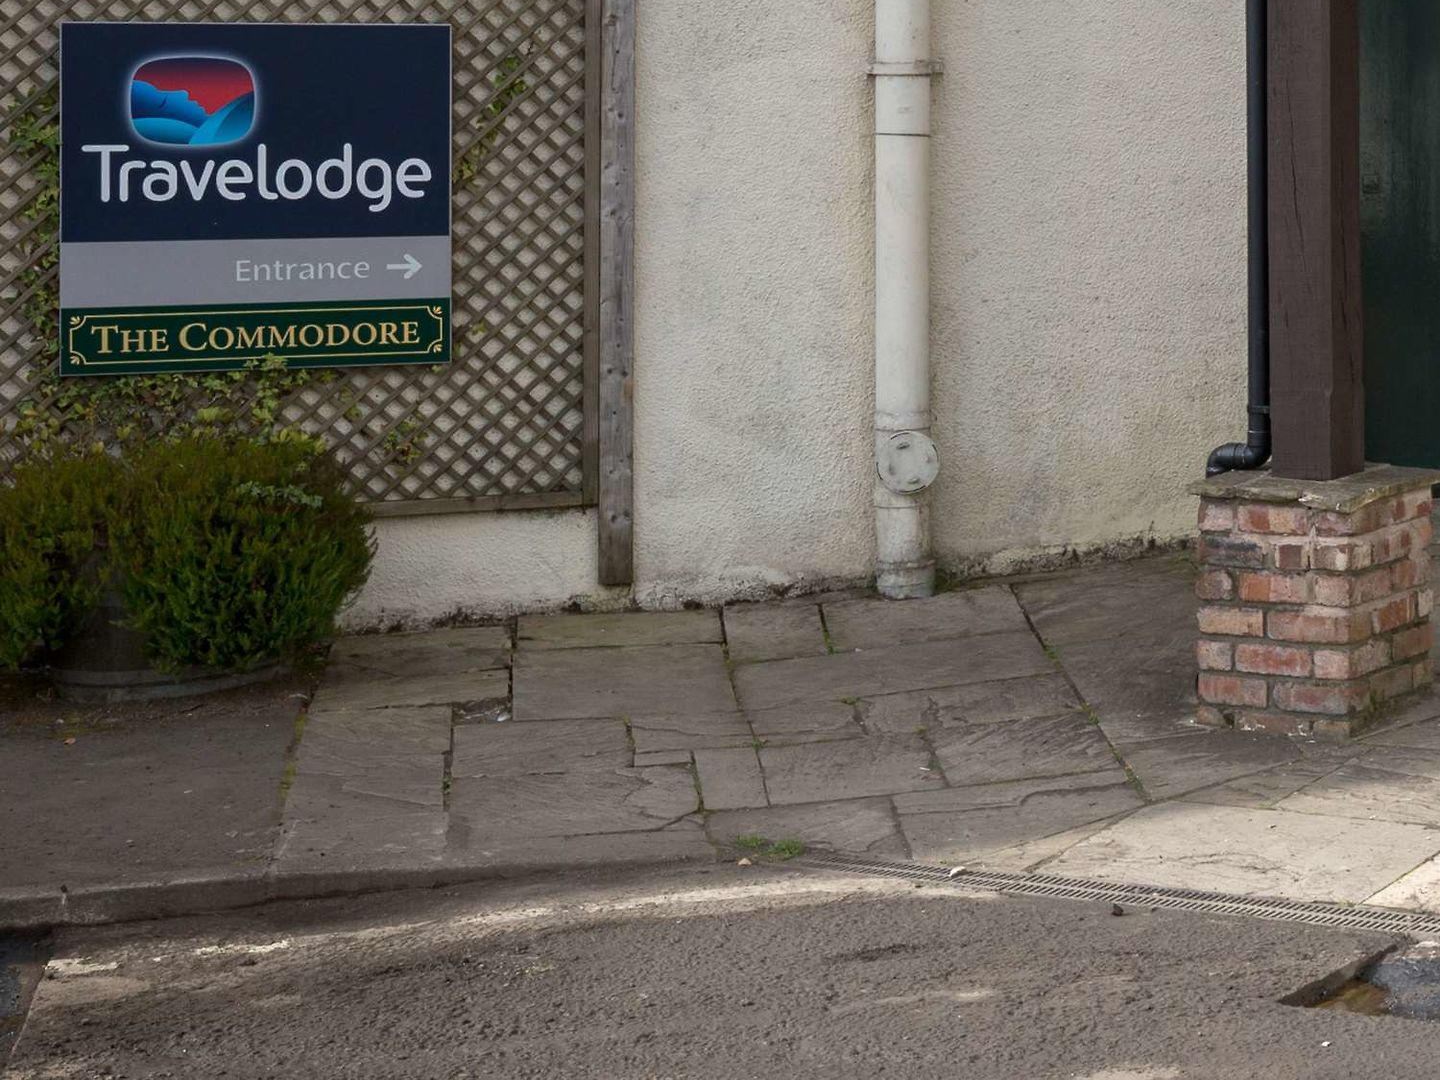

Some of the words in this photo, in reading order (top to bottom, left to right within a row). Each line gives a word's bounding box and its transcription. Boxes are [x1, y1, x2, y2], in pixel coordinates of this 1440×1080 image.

[81, 143, 432, 212] Travelodge
[235, 258, 371, 283] Entrance
[91, 324, 170, 354] THE
[178, 320, 421, 352] COMMODORE
